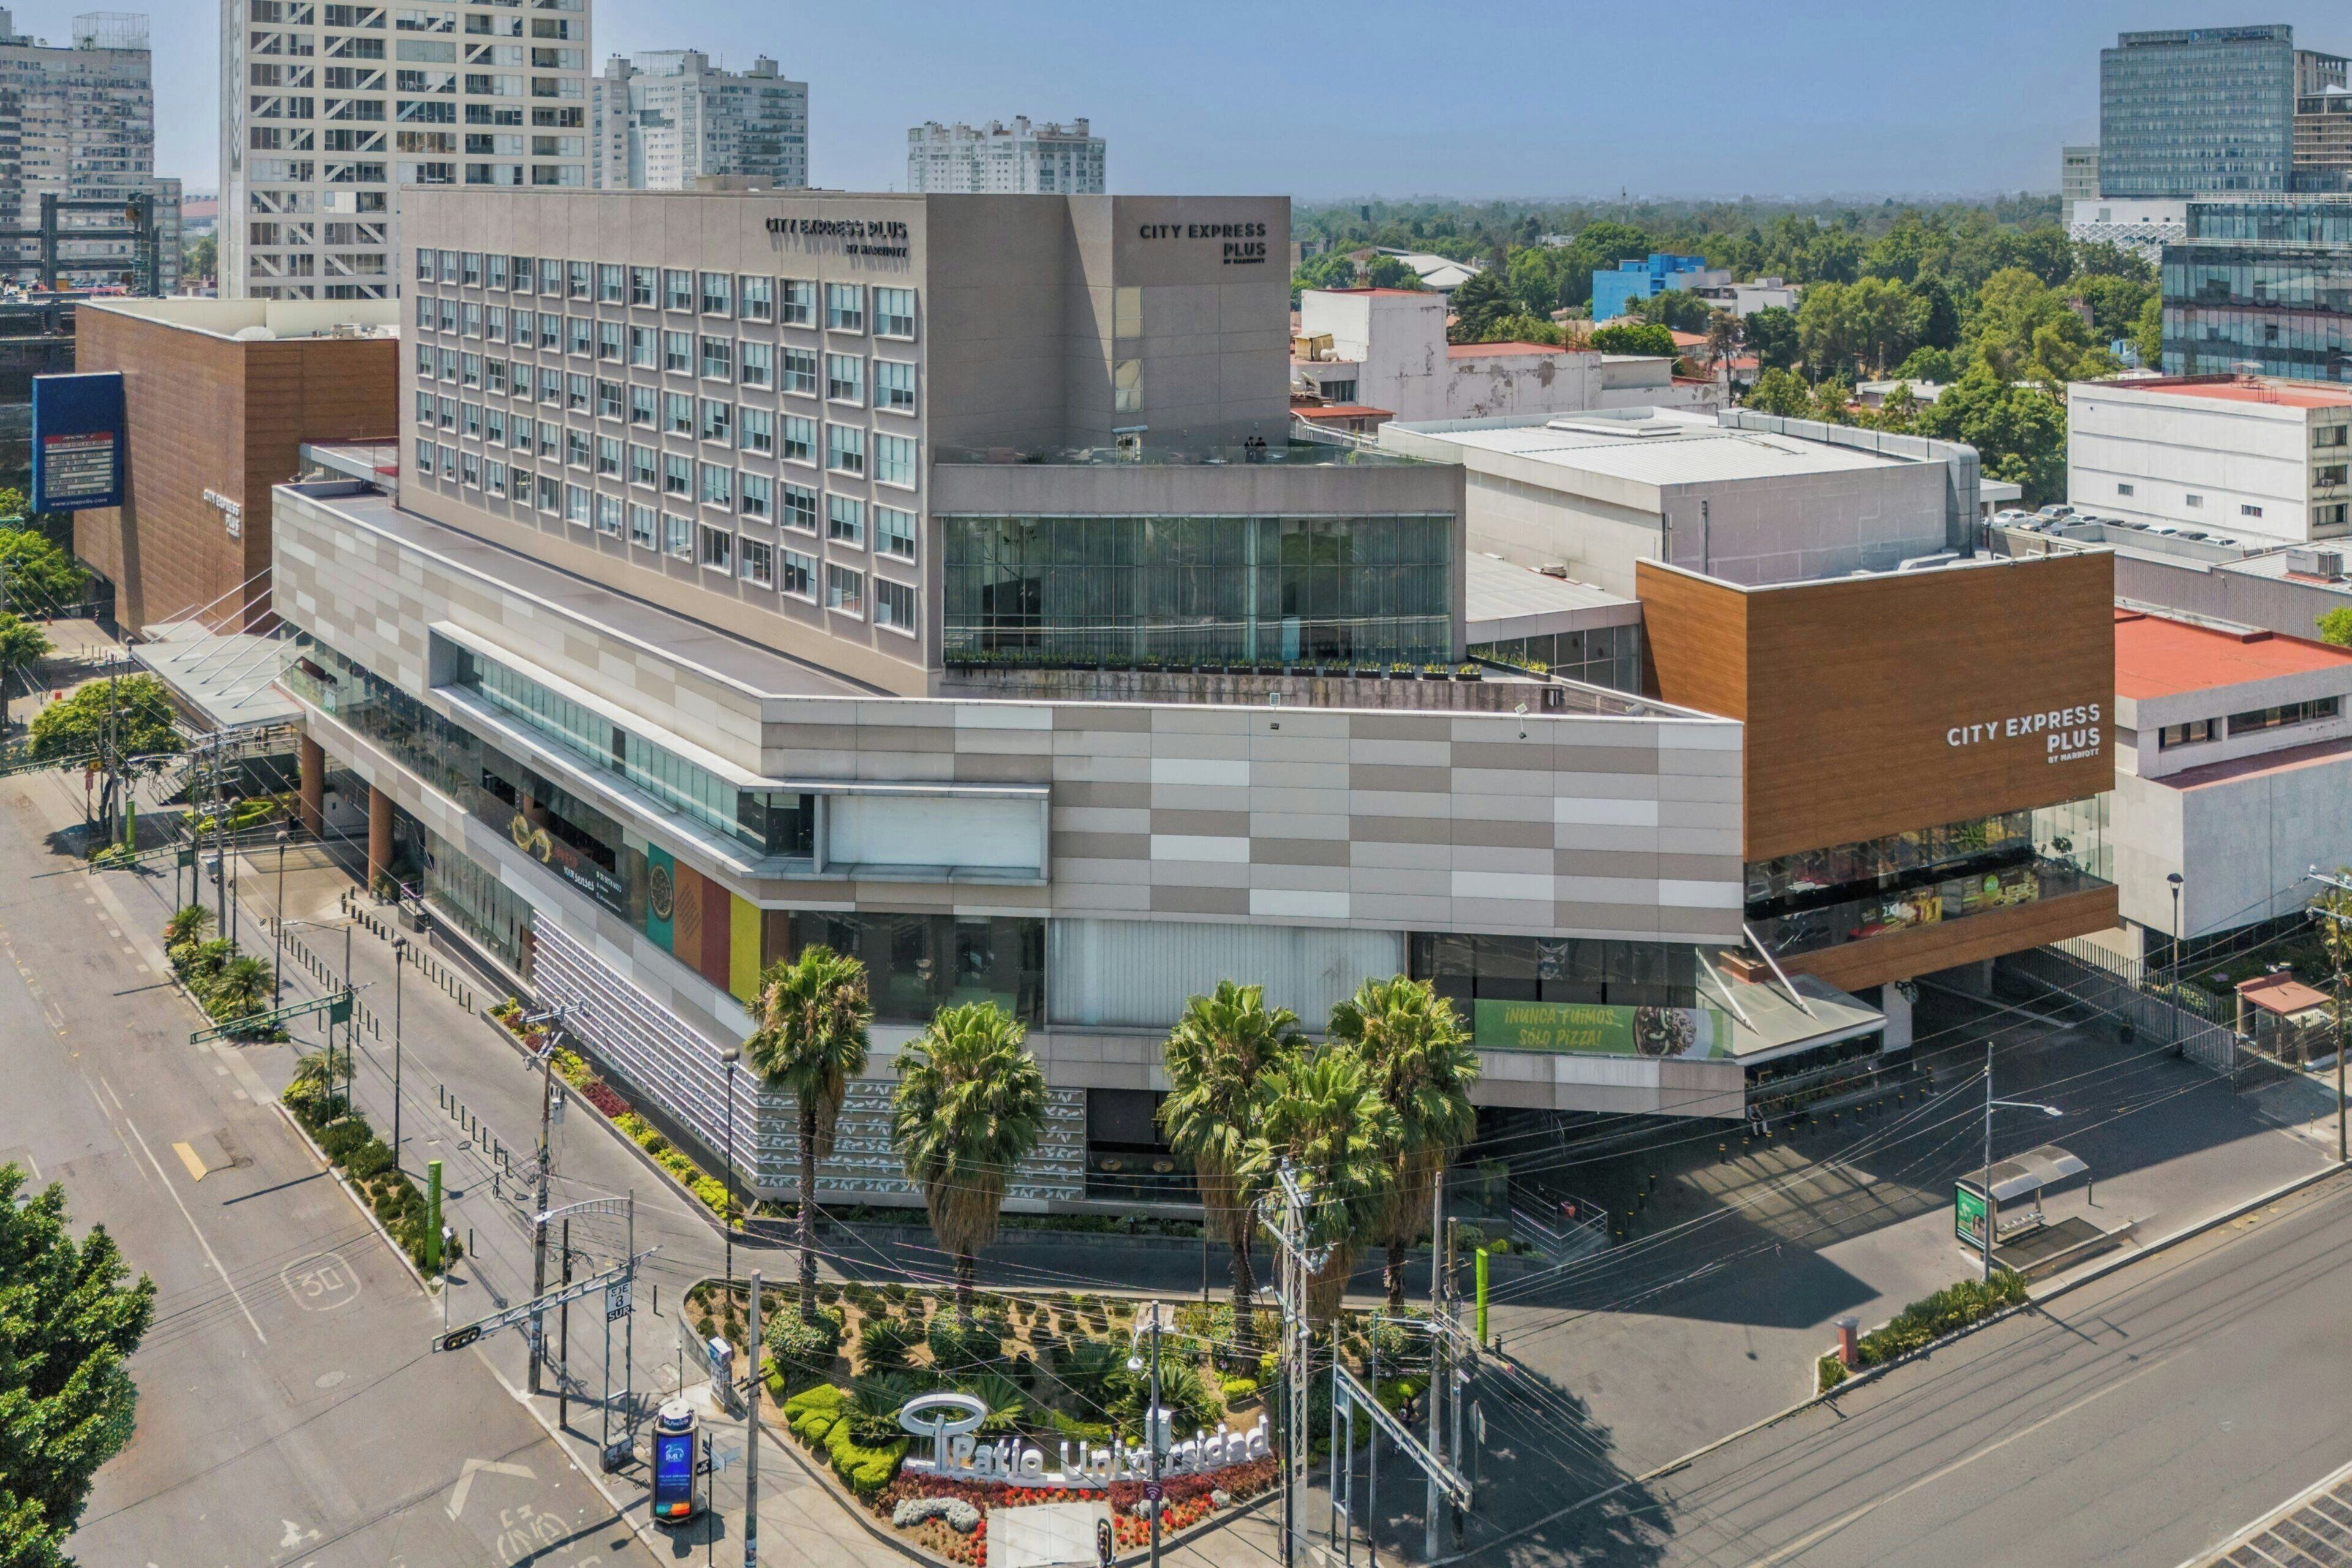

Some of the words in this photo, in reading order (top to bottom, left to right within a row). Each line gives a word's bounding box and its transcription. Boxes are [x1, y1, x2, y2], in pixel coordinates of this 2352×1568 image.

[766, 217, 796, 233] CITY
[799, 219, 865, 237] EXPRESS
[867, 221, 907, 239] PLUS
[1140, 224, 1182, 239] CITY
[1188, 223, 1267, 239] EXPRESS
[860, 246, 907, 258] MARRIOTT
[1223, 242, 1267, 257] PLUS
[1947, 722, 1999, 747] CITY
[2005, 703, 2101, 737] EXPRESS
[2047, 727, 2101, 753] PLUS
[2048, 755, 2059, 764] BY
[2060, 748, 2100, 762] MARRIOTT
[295, 1266, 345, 1297] 30
[611, 1283, 629, 1298] EJE
[615, 1294, 624, 1308] 8
[608, 1306, 631, 1321] SUR
[952, 1432, 1043, 1478] Patio
